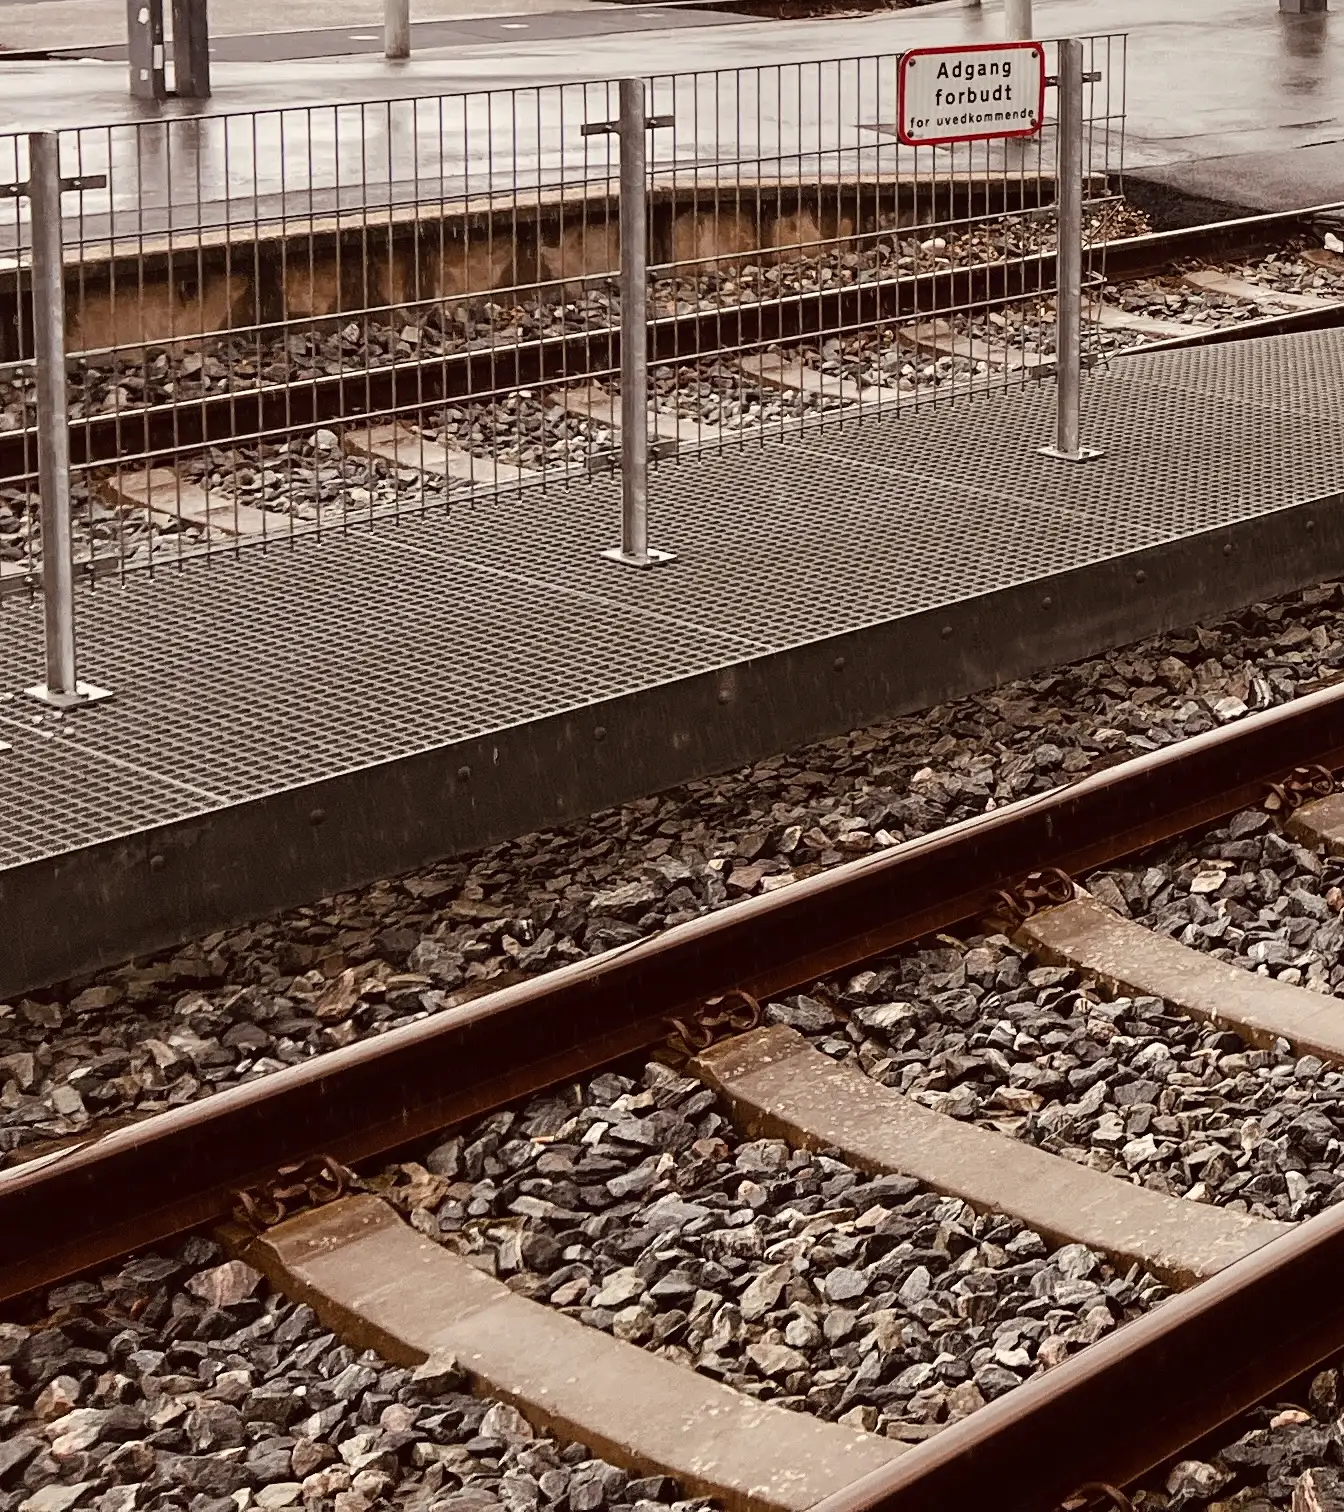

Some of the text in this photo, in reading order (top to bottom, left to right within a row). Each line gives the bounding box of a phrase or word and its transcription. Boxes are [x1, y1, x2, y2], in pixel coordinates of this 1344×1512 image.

[937, 61, 1012, 81] Adgang
[935, 84, 1012, 106] forbudt
[910, 108, 1034, 129] for uvedkommende
